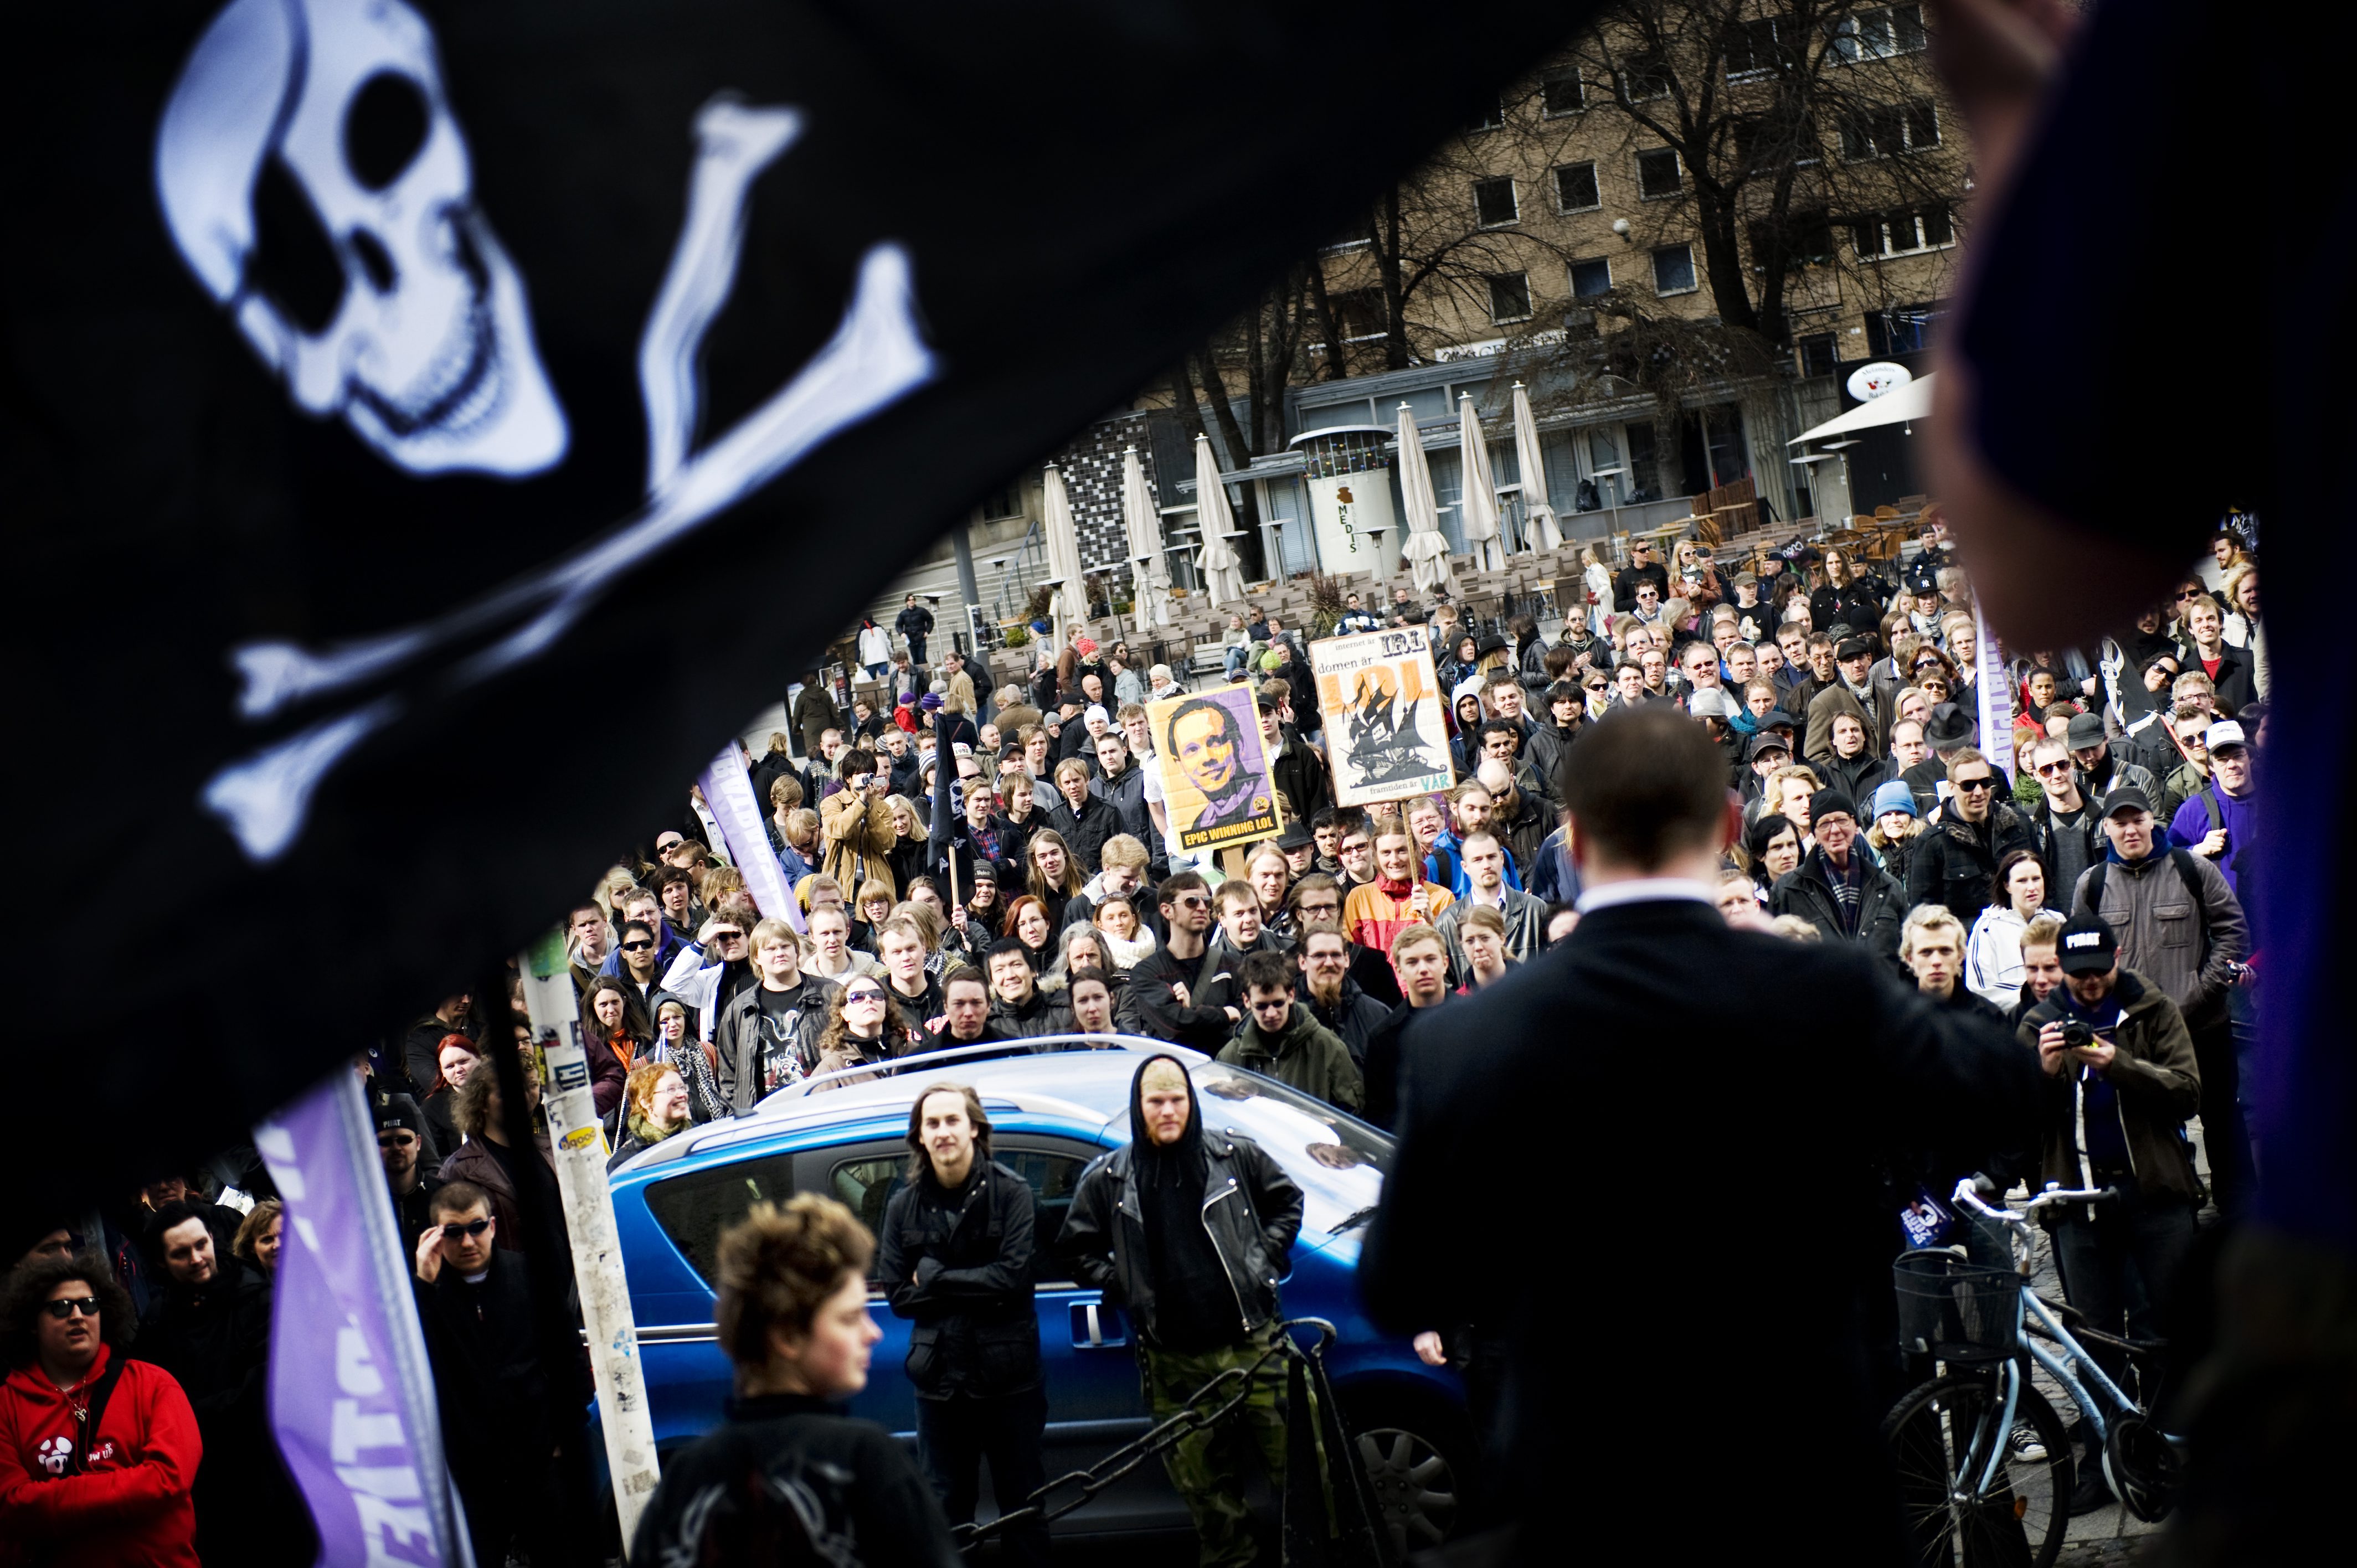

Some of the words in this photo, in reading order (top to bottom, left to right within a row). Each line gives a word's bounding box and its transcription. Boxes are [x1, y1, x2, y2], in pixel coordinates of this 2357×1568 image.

[1339, 505, 1356, 553] MEDIS
[1335, 639, 1365, 651] internet
[1378, 630, 1426, 658] IRL
[1318, 660, 1357, 674] domen
[1361, 657, 1373, 666] är
[1319, 659, 1435, 715] LOL
[1370, 780, 1408, 794] framtiden
[1184, 831, 1208, 846] EPIC
[1208, 821, 1254, 840] WINNING
[1255, 816, 1273, 830] LOL
